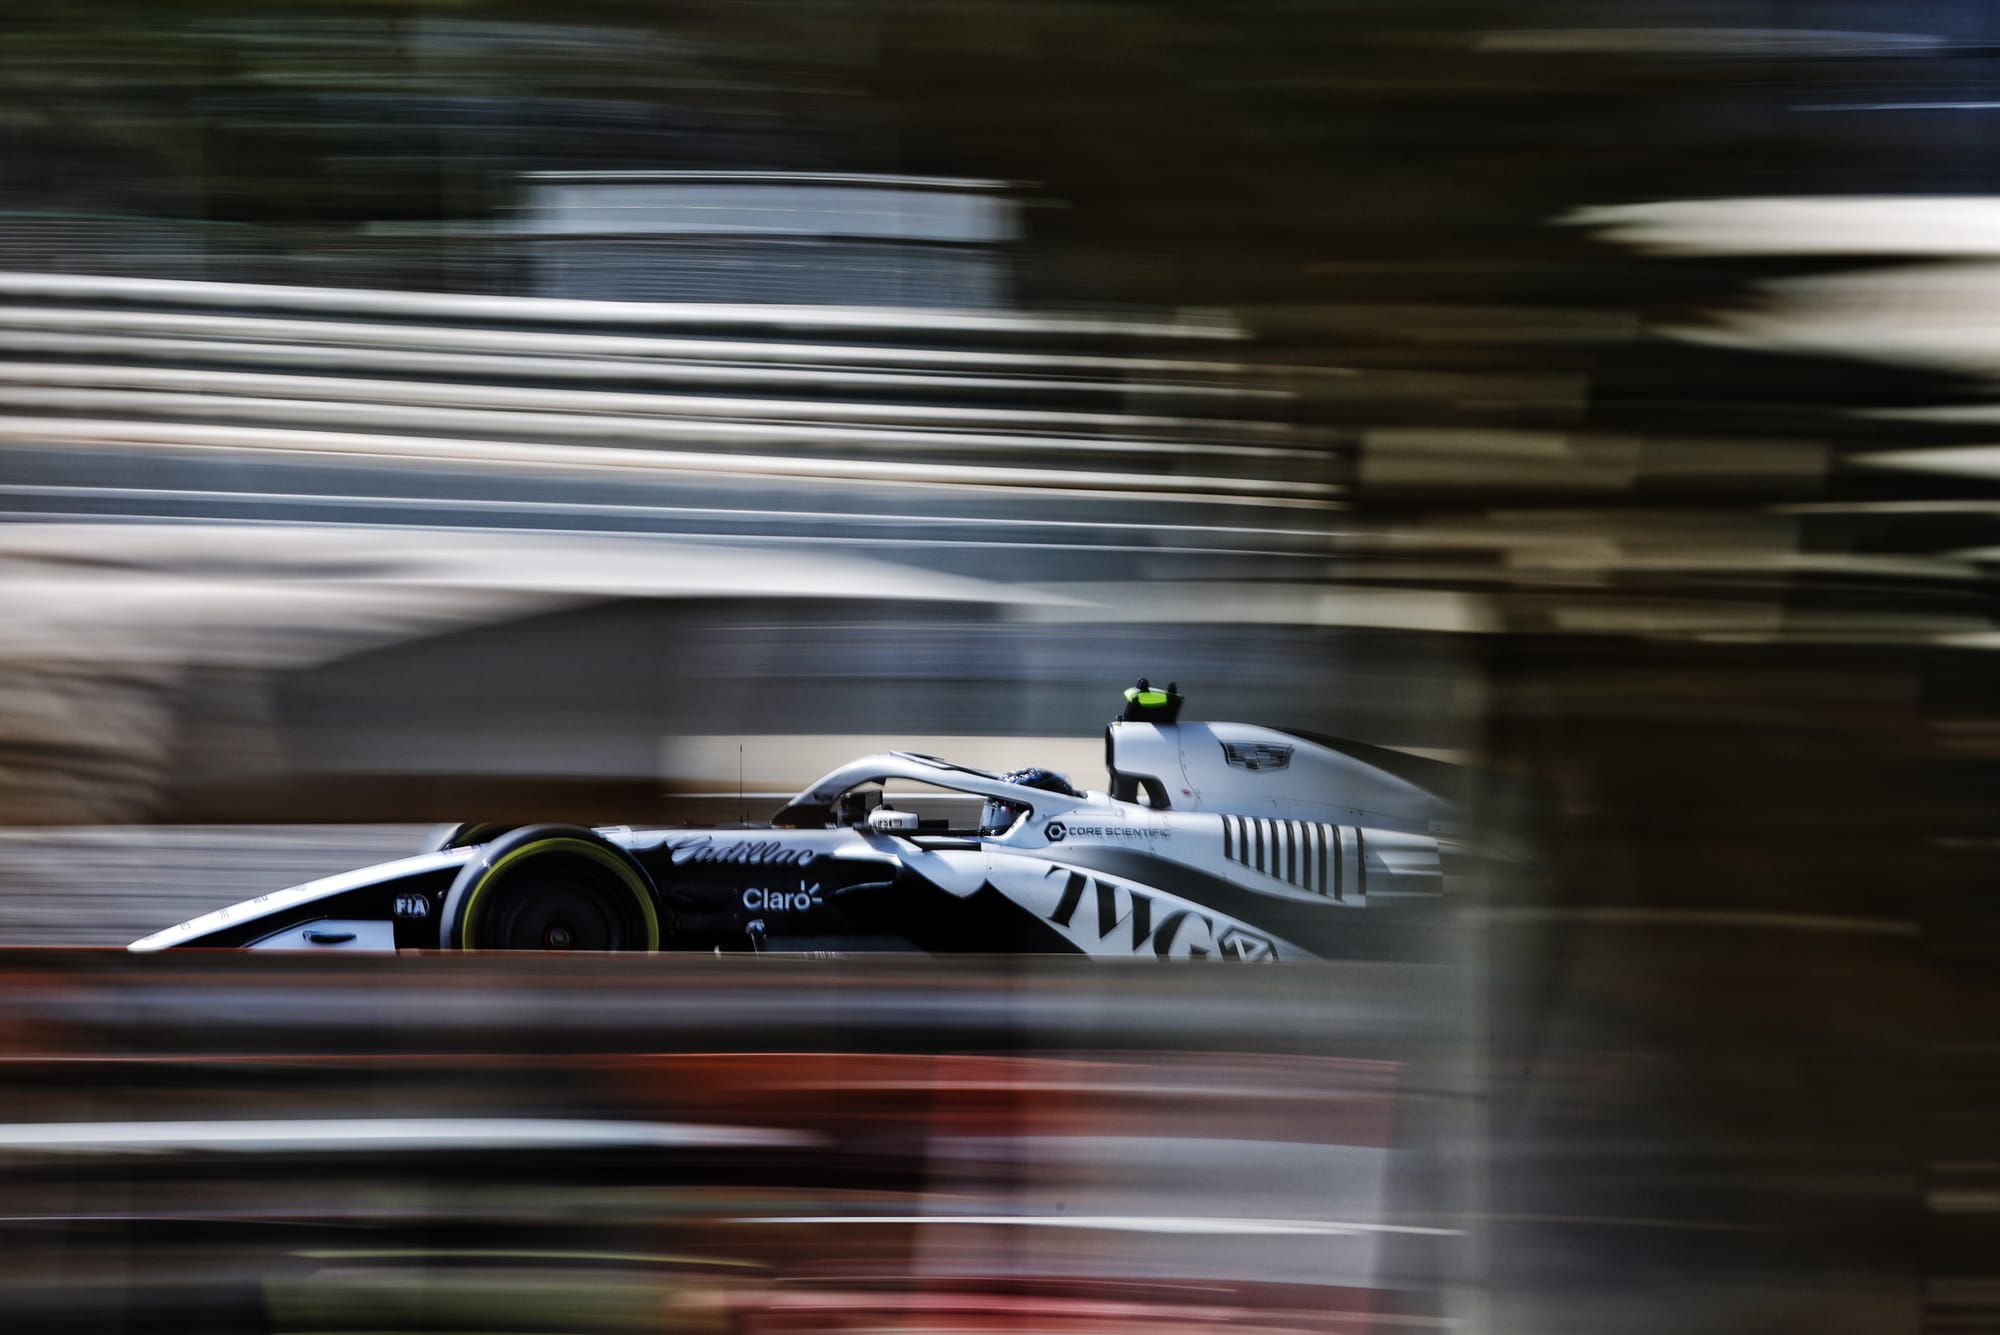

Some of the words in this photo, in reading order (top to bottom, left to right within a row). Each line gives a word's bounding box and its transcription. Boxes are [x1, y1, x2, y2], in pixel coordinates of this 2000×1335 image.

[1069, 826, 1103, 836] CORE
[1104, 827, 1171, 838] SCIENTIFIC
[666, 834, 814, 867] Cadillac
[396, 898, 426, 916] FIA
[743, 882, 817, 911] Claro
[1044, 863, 1213, 961] TWG
